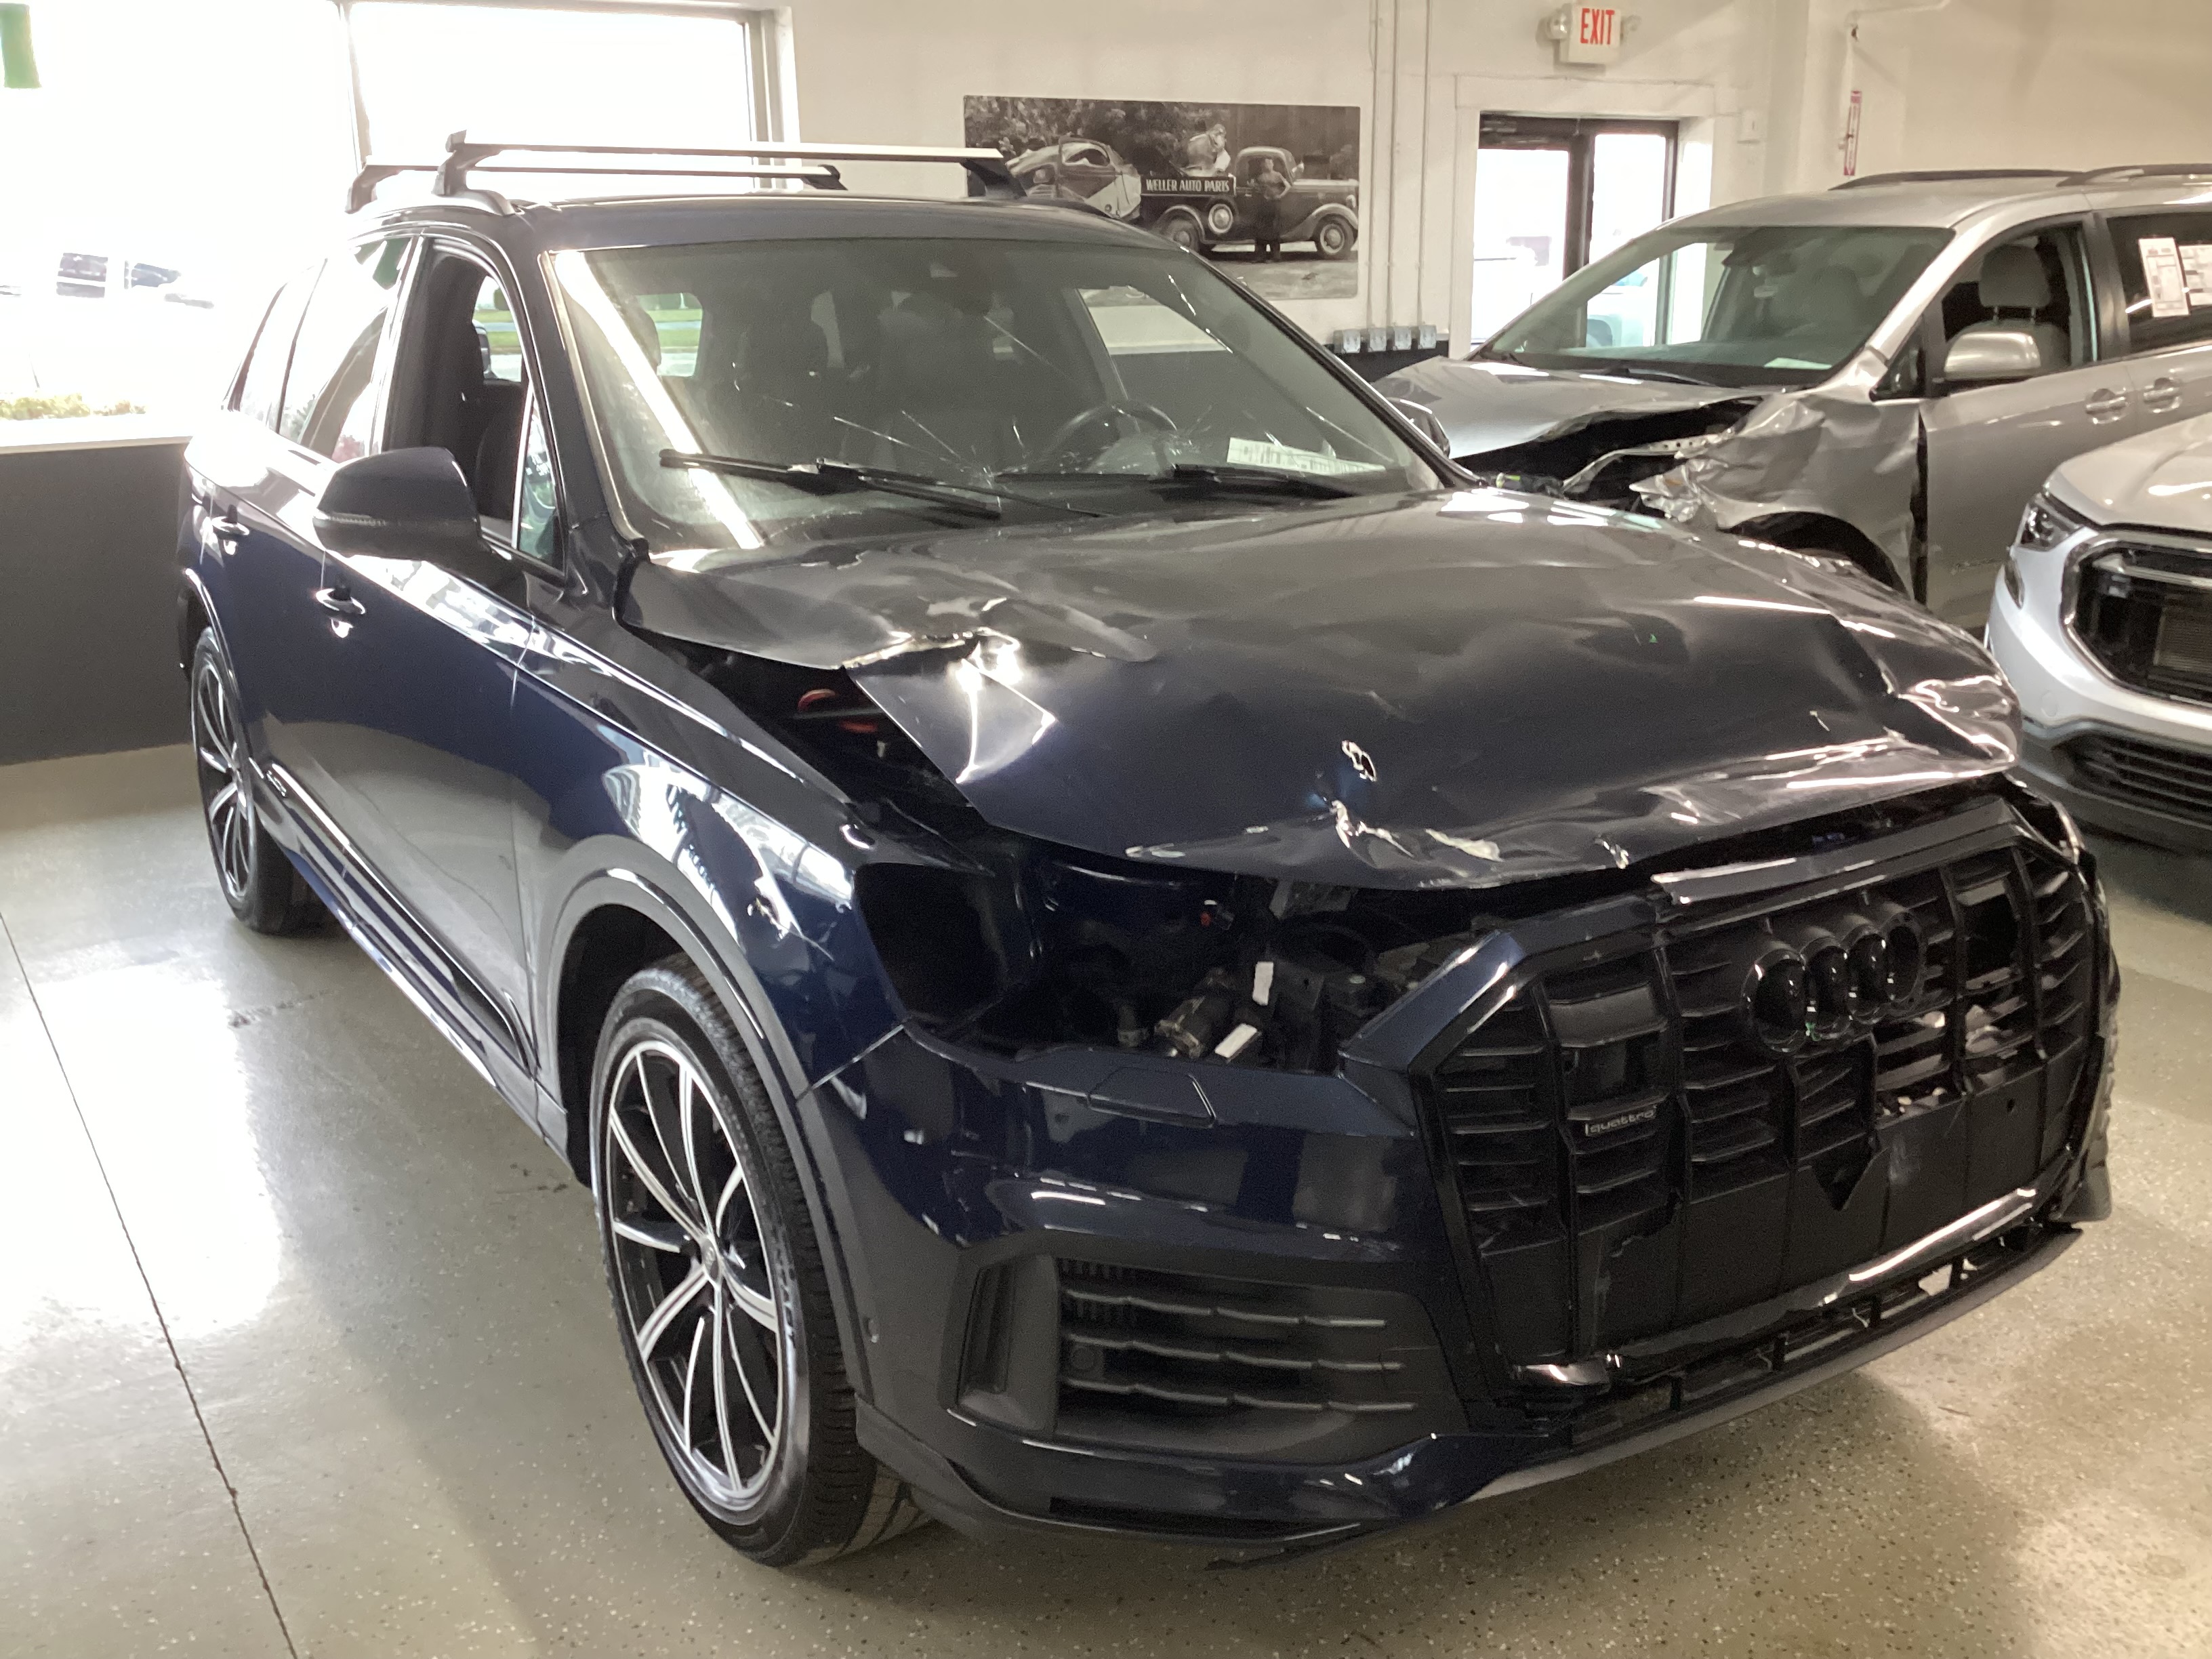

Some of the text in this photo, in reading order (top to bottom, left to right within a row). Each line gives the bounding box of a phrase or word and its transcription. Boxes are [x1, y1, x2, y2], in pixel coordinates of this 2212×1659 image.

[1580, 8, 1616, 45] EXIT
[1146, 179, 1230, 192] WELLER AUTO PARTS
[1590, 1109, 1654, 1132] quattro
